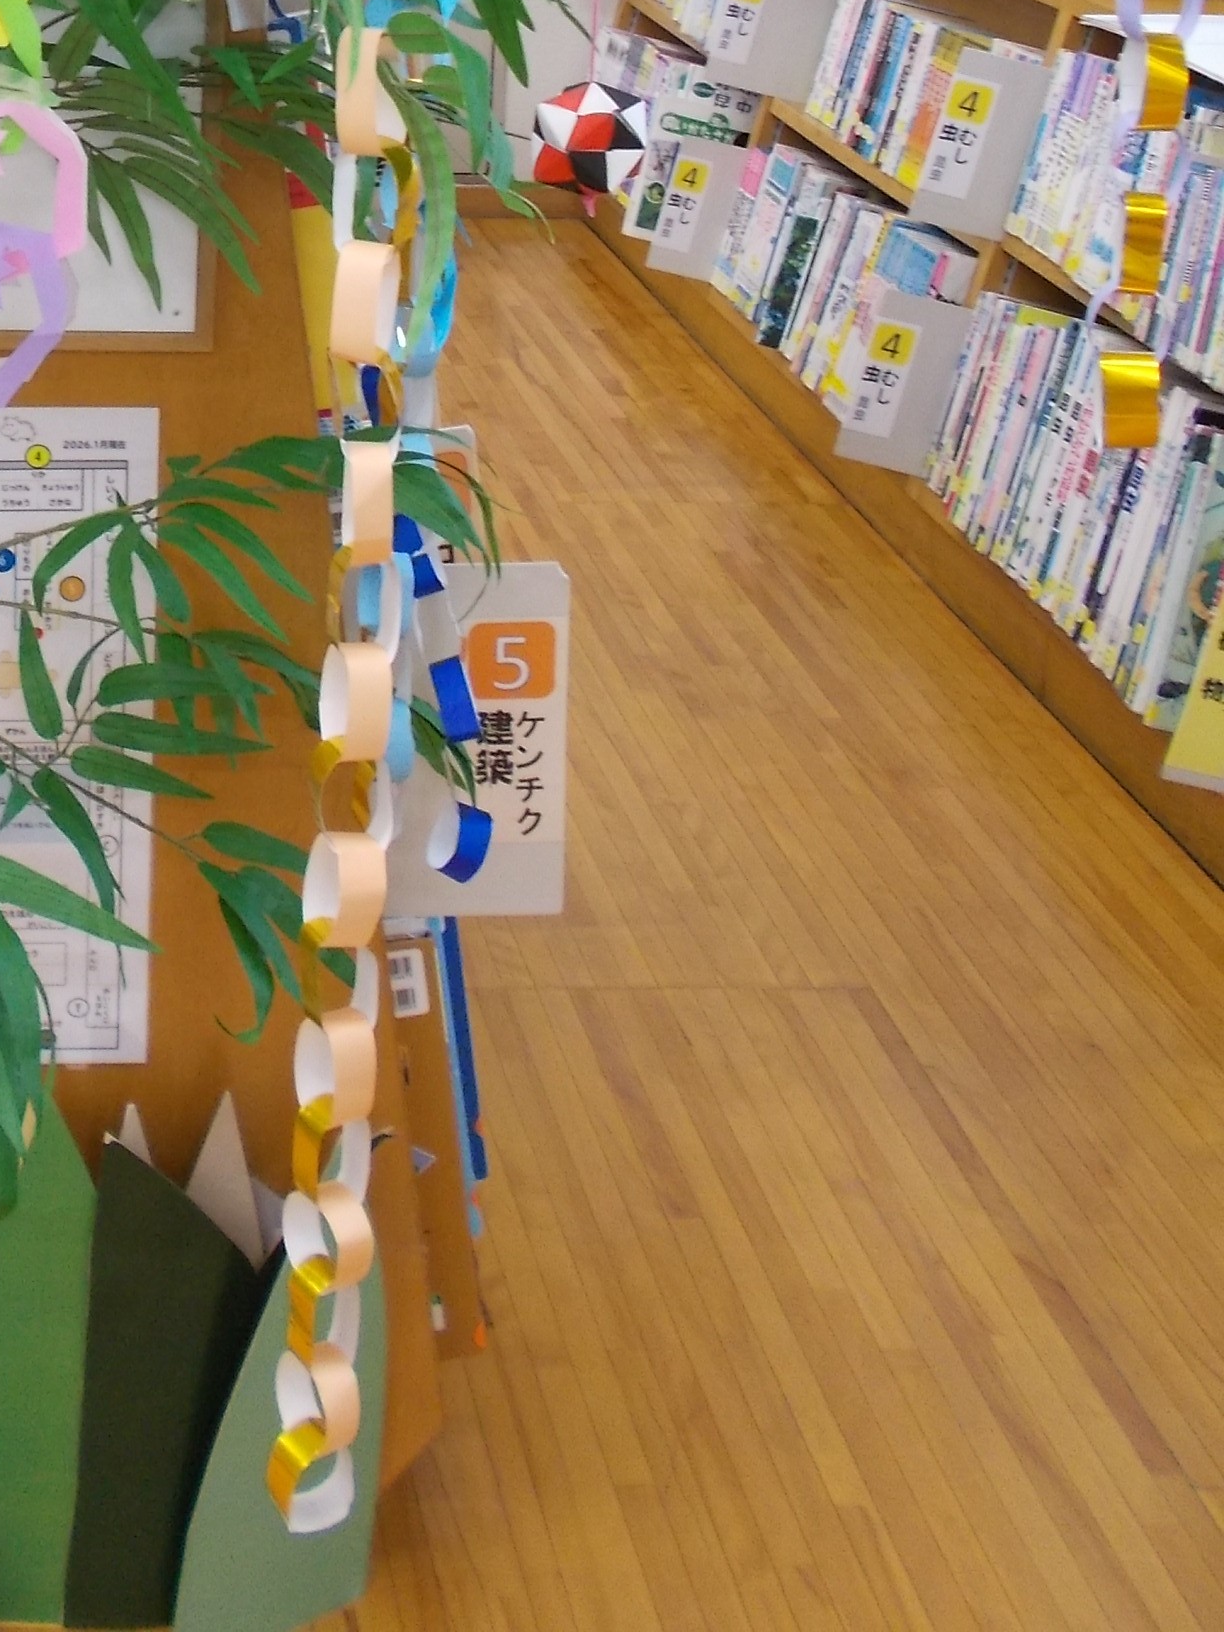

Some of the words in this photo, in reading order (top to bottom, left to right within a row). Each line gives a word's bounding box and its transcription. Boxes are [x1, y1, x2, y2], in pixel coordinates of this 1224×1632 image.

[725, 3, 742, 18] 虫
[737, 7, 756, 36] むし
[958, 91, 979, 118] 4
[938, 124, 958, 142] 虫
[954, 129, 978, 164] むし
[681, 167, 698, 188] 4
[667, 193, 683, 208] 虫
[679, 197, 697, 225] むし
[881, 333, 902, 359] 4
[861, 366, 881, 383] 虫
[877, 370, 900, 405] むし
[492, 635, 531, 691] 5
[476, 709, 515, 786] 建築
[515, 710, 545, 836] ケンチク
